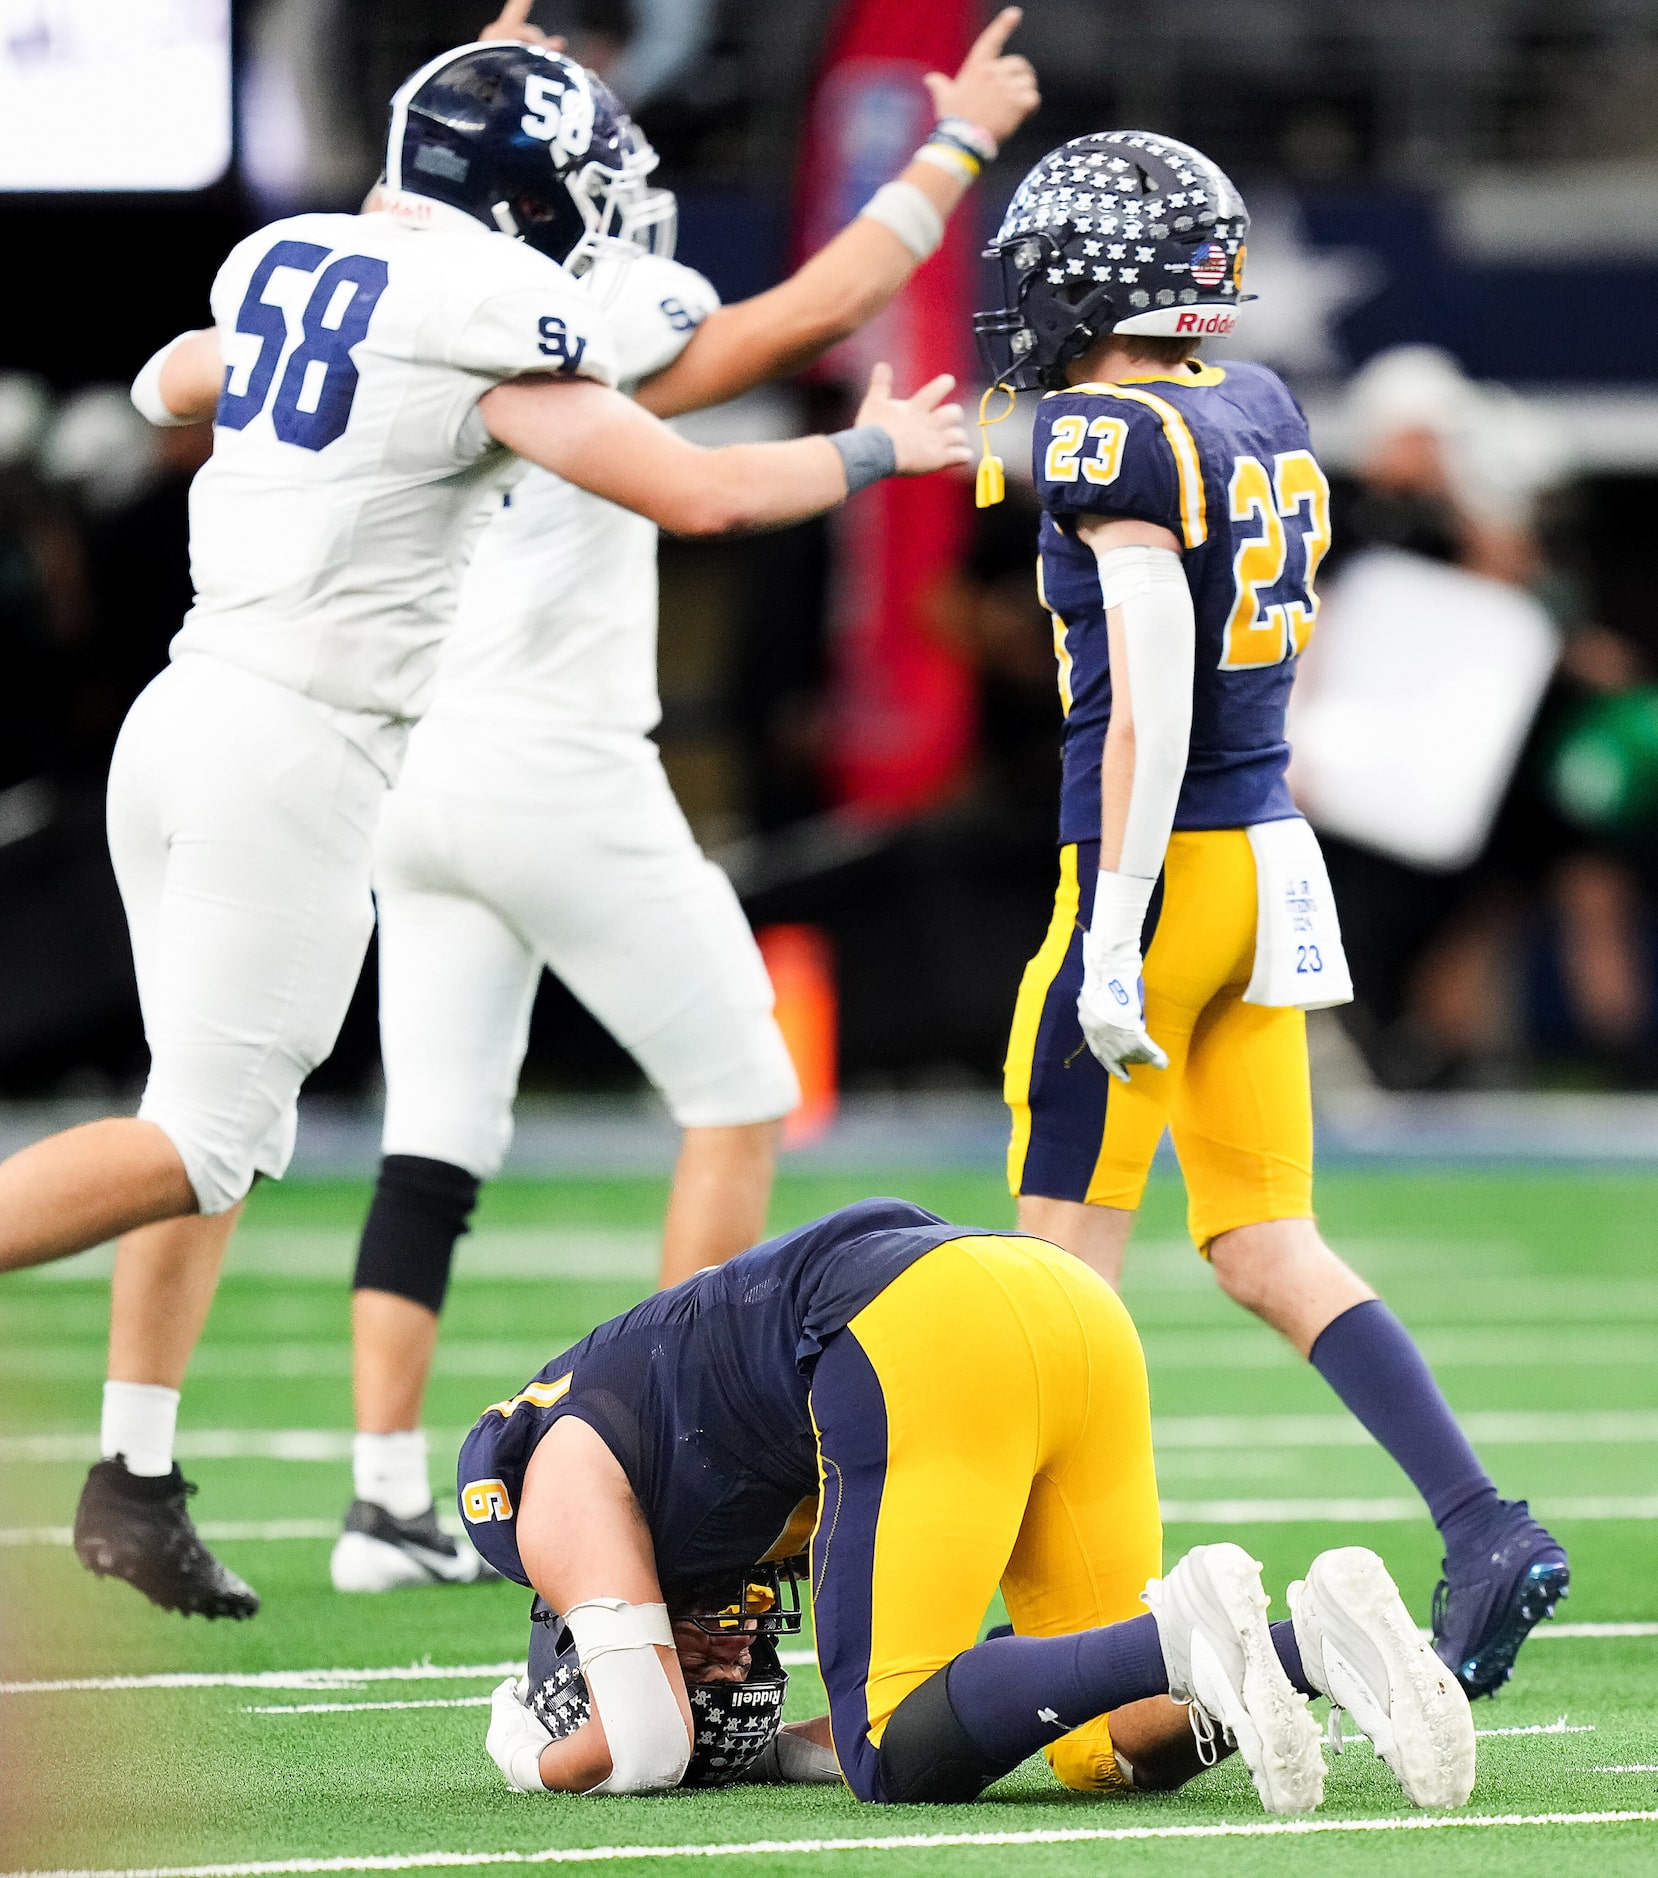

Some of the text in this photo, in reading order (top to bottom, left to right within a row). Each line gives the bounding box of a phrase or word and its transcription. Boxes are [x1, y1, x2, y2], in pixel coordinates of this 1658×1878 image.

[521, 74, 595, 155] 58
[217, 240, 389, 452] 58
[538, 316, 587, 373] SV
[1045, 415, 1129, 486] 23
[1217, 449, 1331, 671] 23
[1296, 945, 1323, 973] 23
[731, 1689, 781, 1707] Riddell
